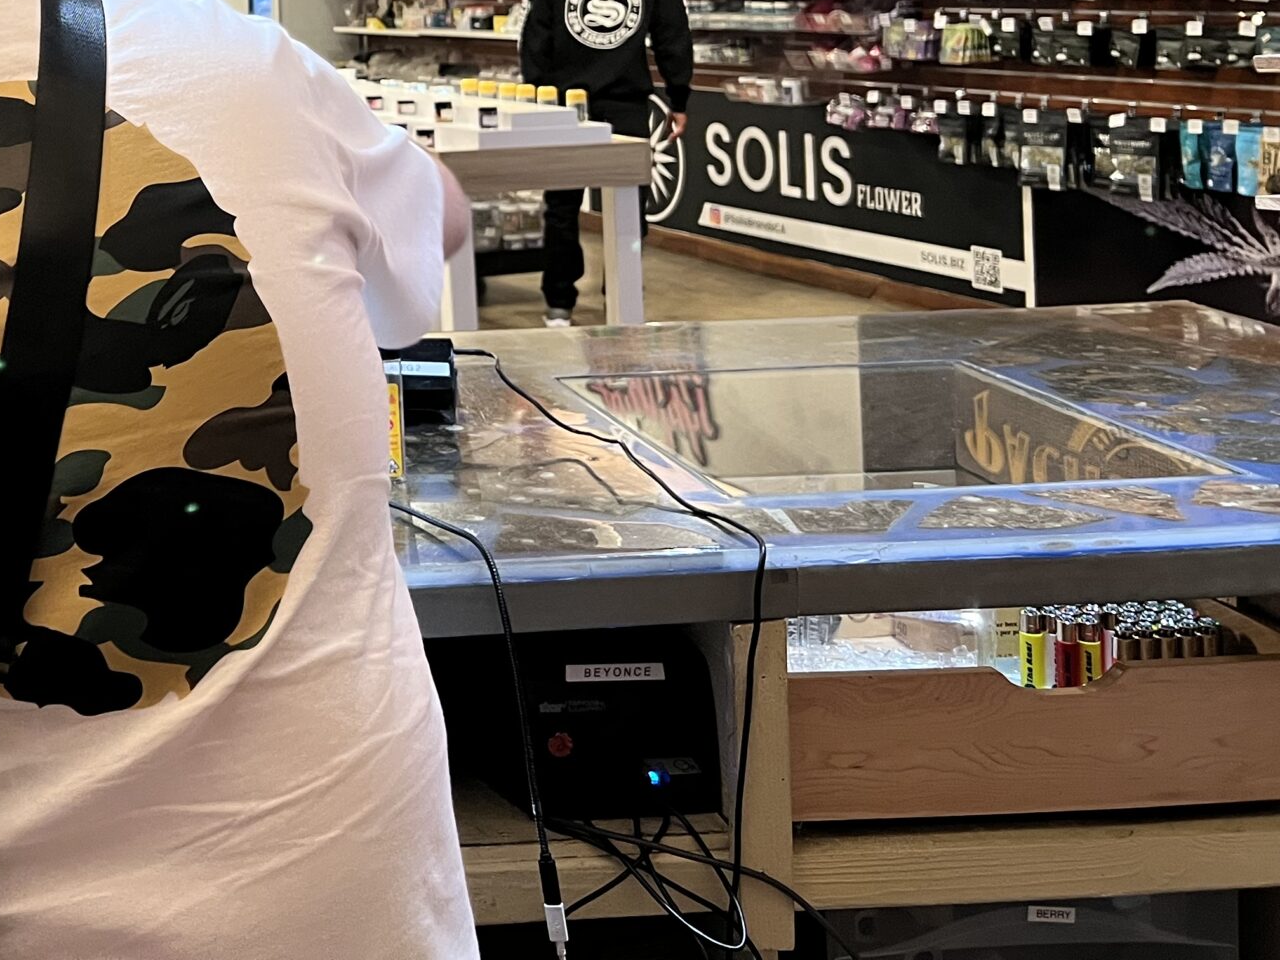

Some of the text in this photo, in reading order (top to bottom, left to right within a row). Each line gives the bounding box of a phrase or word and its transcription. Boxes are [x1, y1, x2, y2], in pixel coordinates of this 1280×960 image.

[704, 121, 853, 207] SOLIS
[856, 183, 925, 218] FLOWER
[584, 666, 652, 678] BEYONCE
[1036, 908, 1071, 920] BERRY
